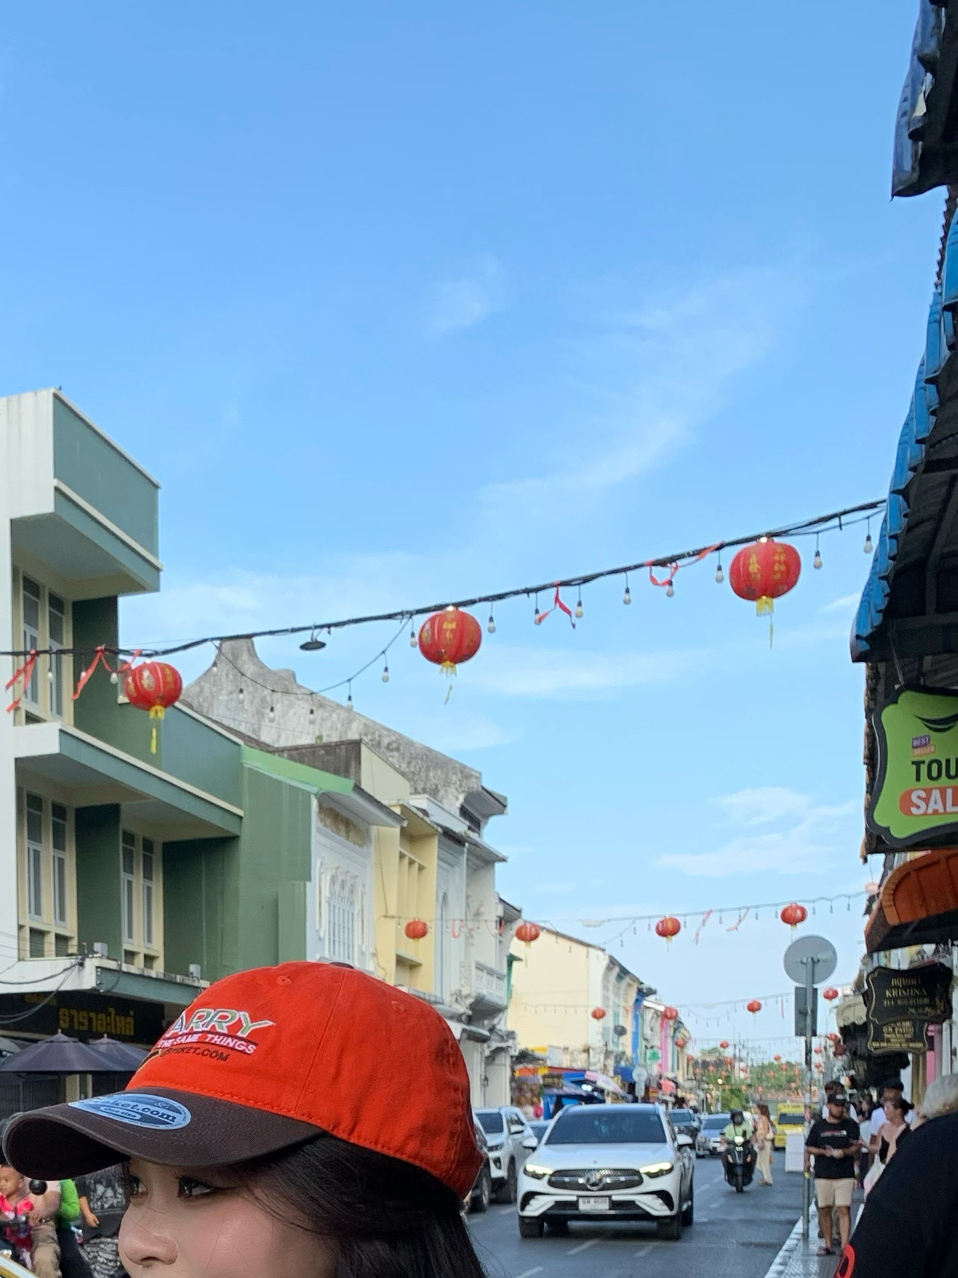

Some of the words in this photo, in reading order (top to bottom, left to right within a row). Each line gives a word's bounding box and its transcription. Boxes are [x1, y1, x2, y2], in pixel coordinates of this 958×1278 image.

[912, 758, 958, 782] TOU
[910, 788, 958, 815] SAL
[165, 1008, 277, 1038] ARRY
[205, 1033, 257, 1054] THINGS
